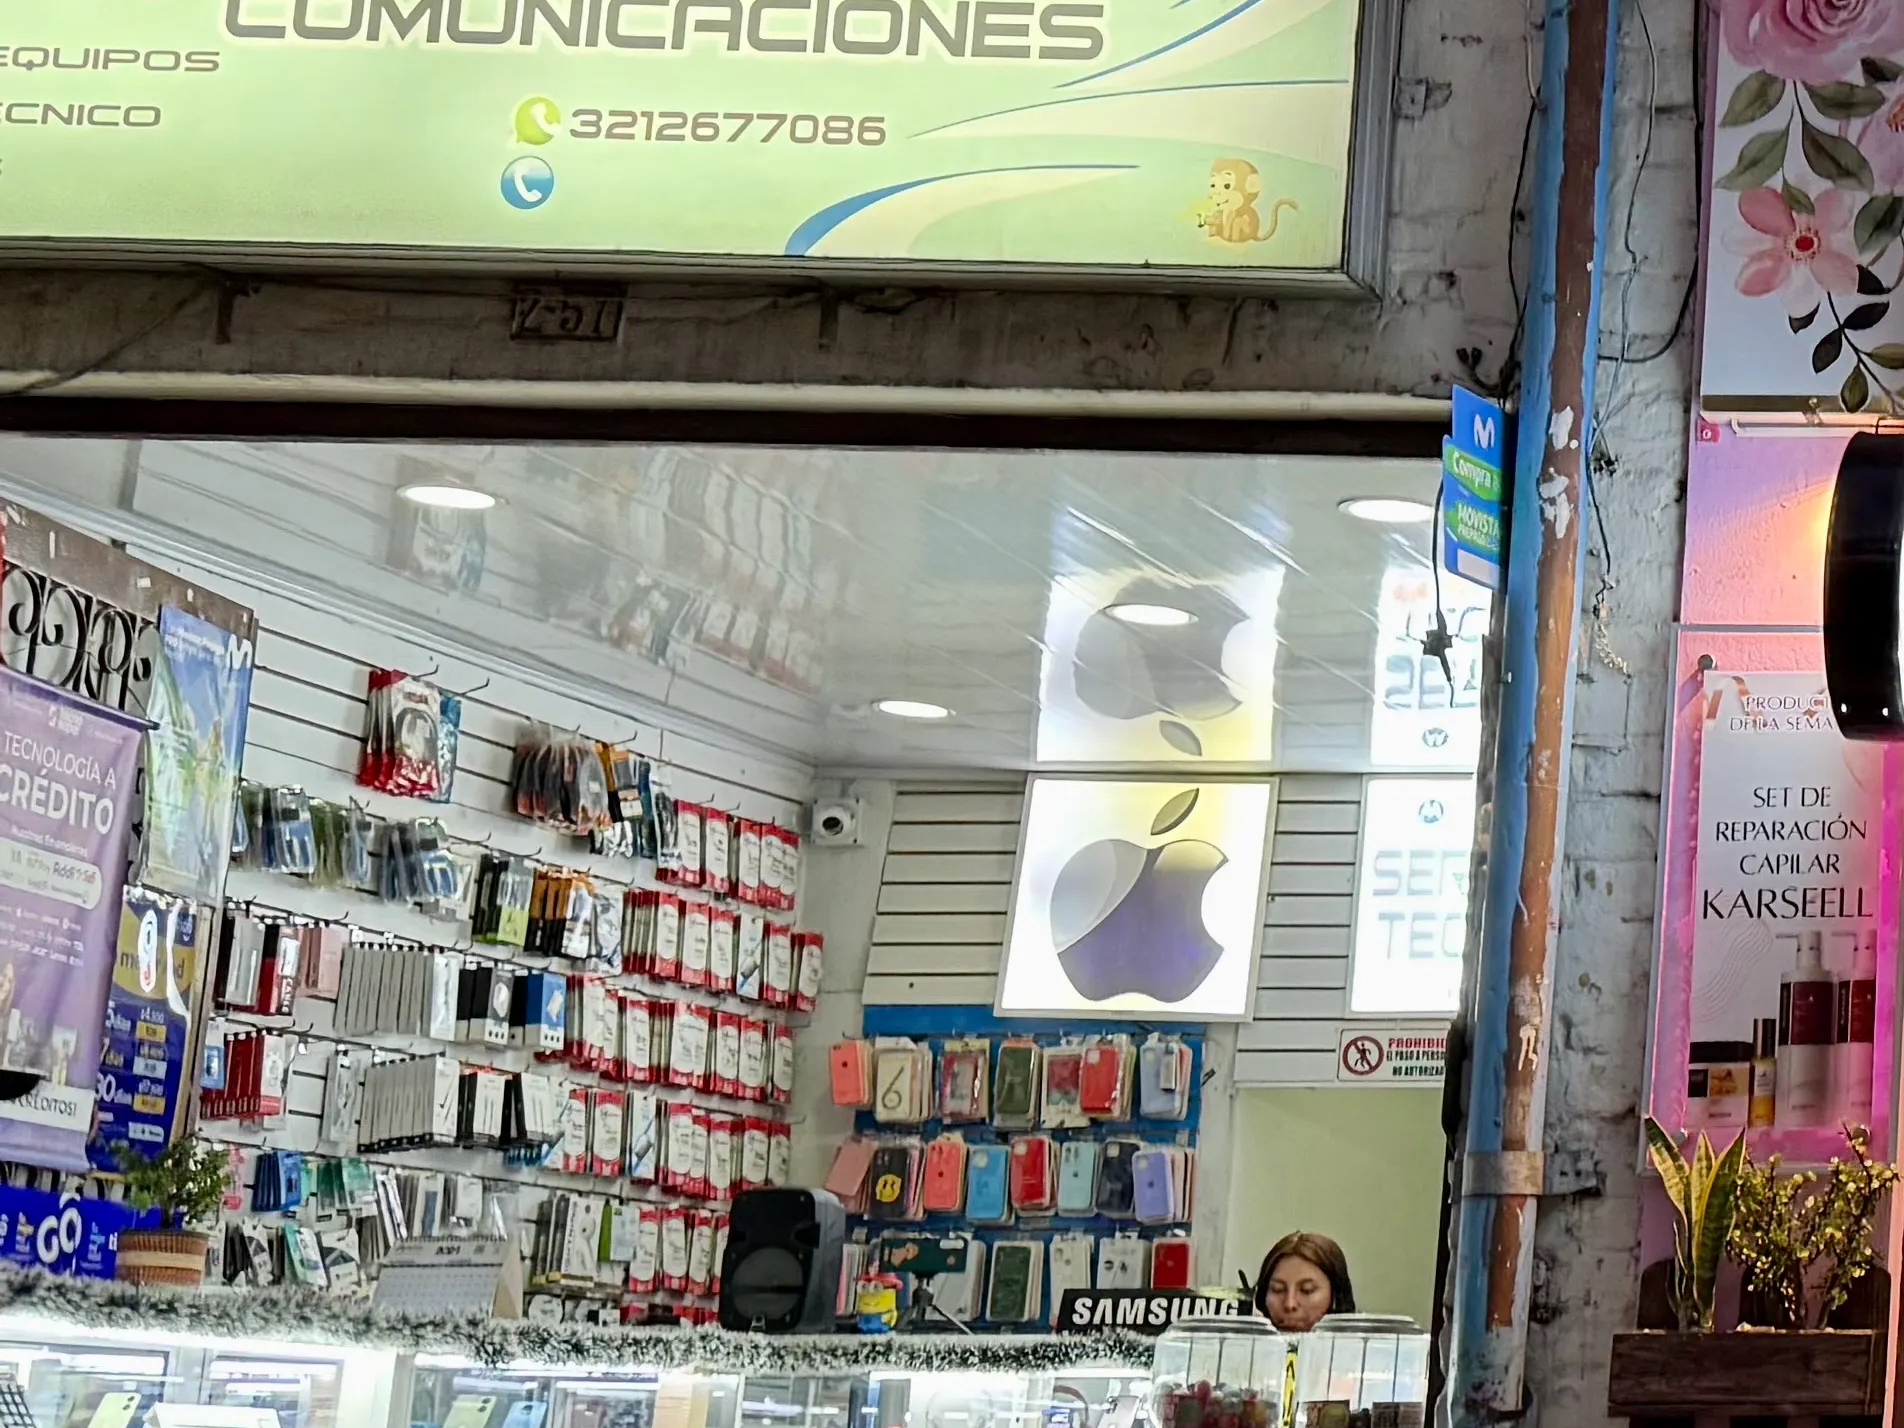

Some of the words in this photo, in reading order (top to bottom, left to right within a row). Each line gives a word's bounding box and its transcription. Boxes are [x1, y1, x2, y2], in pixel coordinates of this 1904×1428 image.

[0, 102, 161, 128] CNICO
[568, 106, 887, 146] 3212677086
[4, 729, 101, 785] TECNOLOGÍA
[104, 767, 117, 791] A
[0, 762, 114, 835] CRÉDITO
[1752, 785, 1793, 809] SET
[1800, 785, 1832, 808] DE
[1715, 810, 1868, 842] REPARACIÓN
[1738, 853, 1840, 876] CAPILAR
[1701, 886, 1874, 921] KARSEELL
[1071, 1297, 1240, 1326] SAMSUNG
